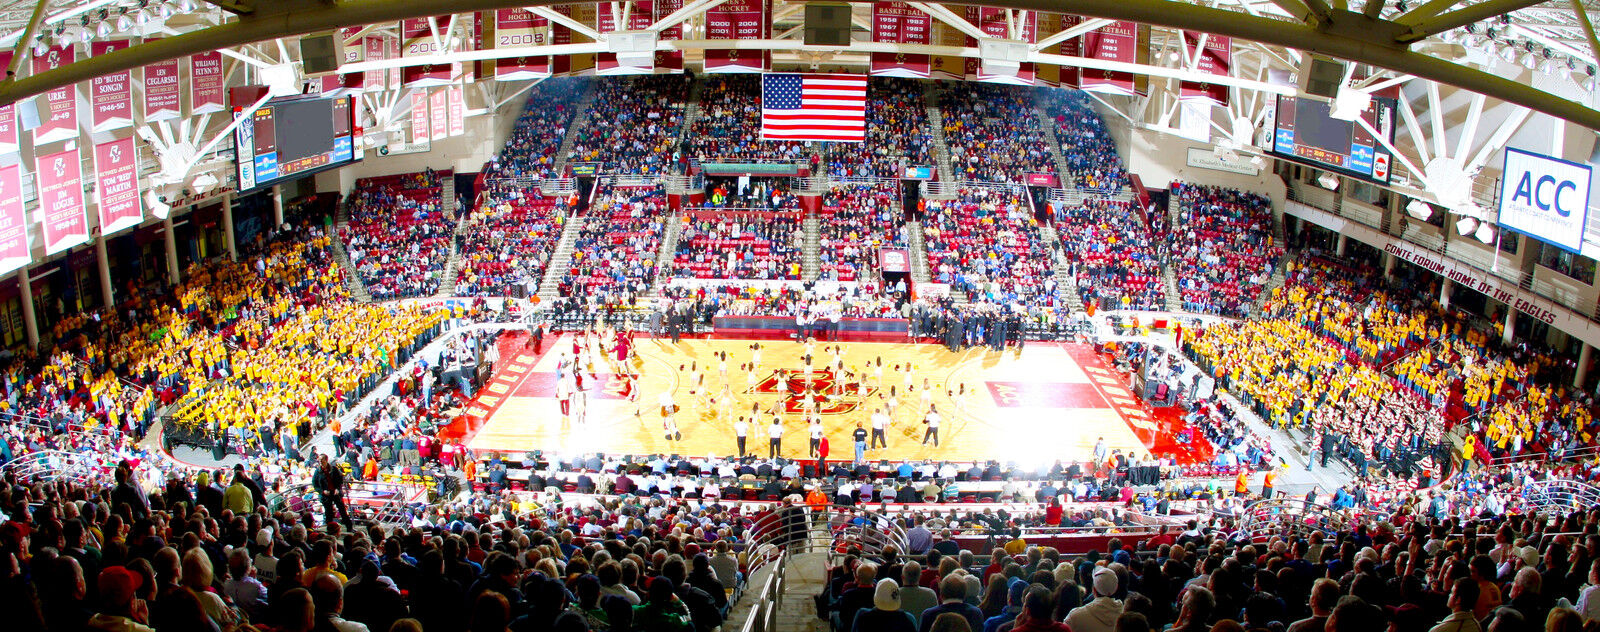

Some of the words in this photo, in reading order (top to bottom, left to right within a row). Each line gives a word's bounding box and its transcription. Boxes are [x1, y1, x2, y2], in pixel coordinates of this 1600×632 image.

[879, 8, 926, 16] BASKETBALL
[500, 34, 544, 45] 2008
[196, 68, 212, 76] FLYNN
[104, 74, 128, 84] "BUTCH"
[147, 76, 177, 86] CEGLARSKI
[99, 83, 123, 94] SONGIN
[48, 90, 66, 101] URKE
[1374, 162, 1387, 171] Gulf
[104, 177, 117, 186] TOM
[106, 181, 132, 196] MARTIN
[1512, 170, 1576, 218] ACC
[53, 196, 74, 212] LOGUE
[1384, 243, 1411, 260] CONTE
[1413, 254, 1444, 274] FORUM
[1450, 268, 1476, 288] HOME
[1478, 282, 1492, 294] OF
[1494, 288, 1511, 305] THE
[1514, 300, 1558, 324] EAGLES
[466, 354, 536, 418] EAGLES
